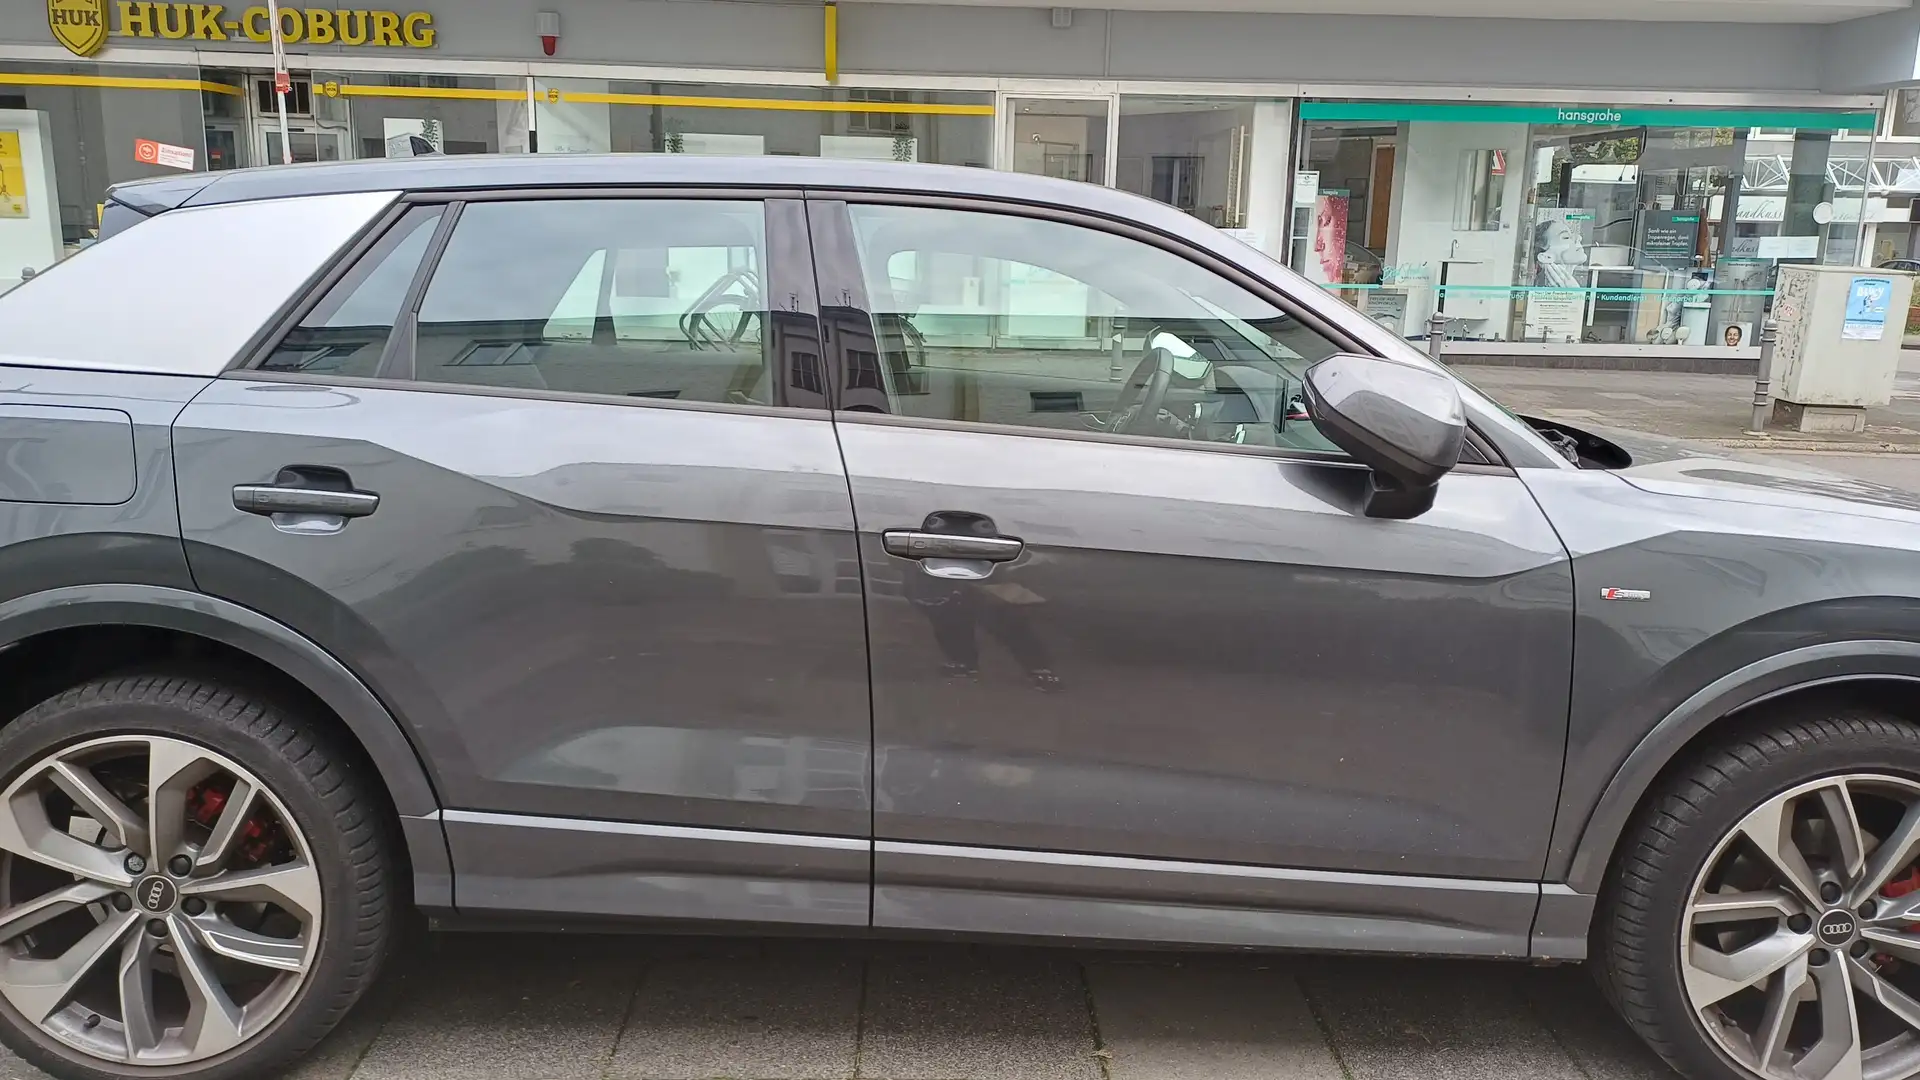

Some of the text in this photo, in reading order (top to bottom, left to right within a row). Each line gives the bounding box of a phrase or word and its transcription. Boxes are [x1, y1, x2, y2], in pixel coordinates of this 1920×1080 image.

[52, 9, 101, 27] HUK
[117, 0, 436, 48] HUK-COBURG
[1557, 107, 1622, 124] hansgrohe
